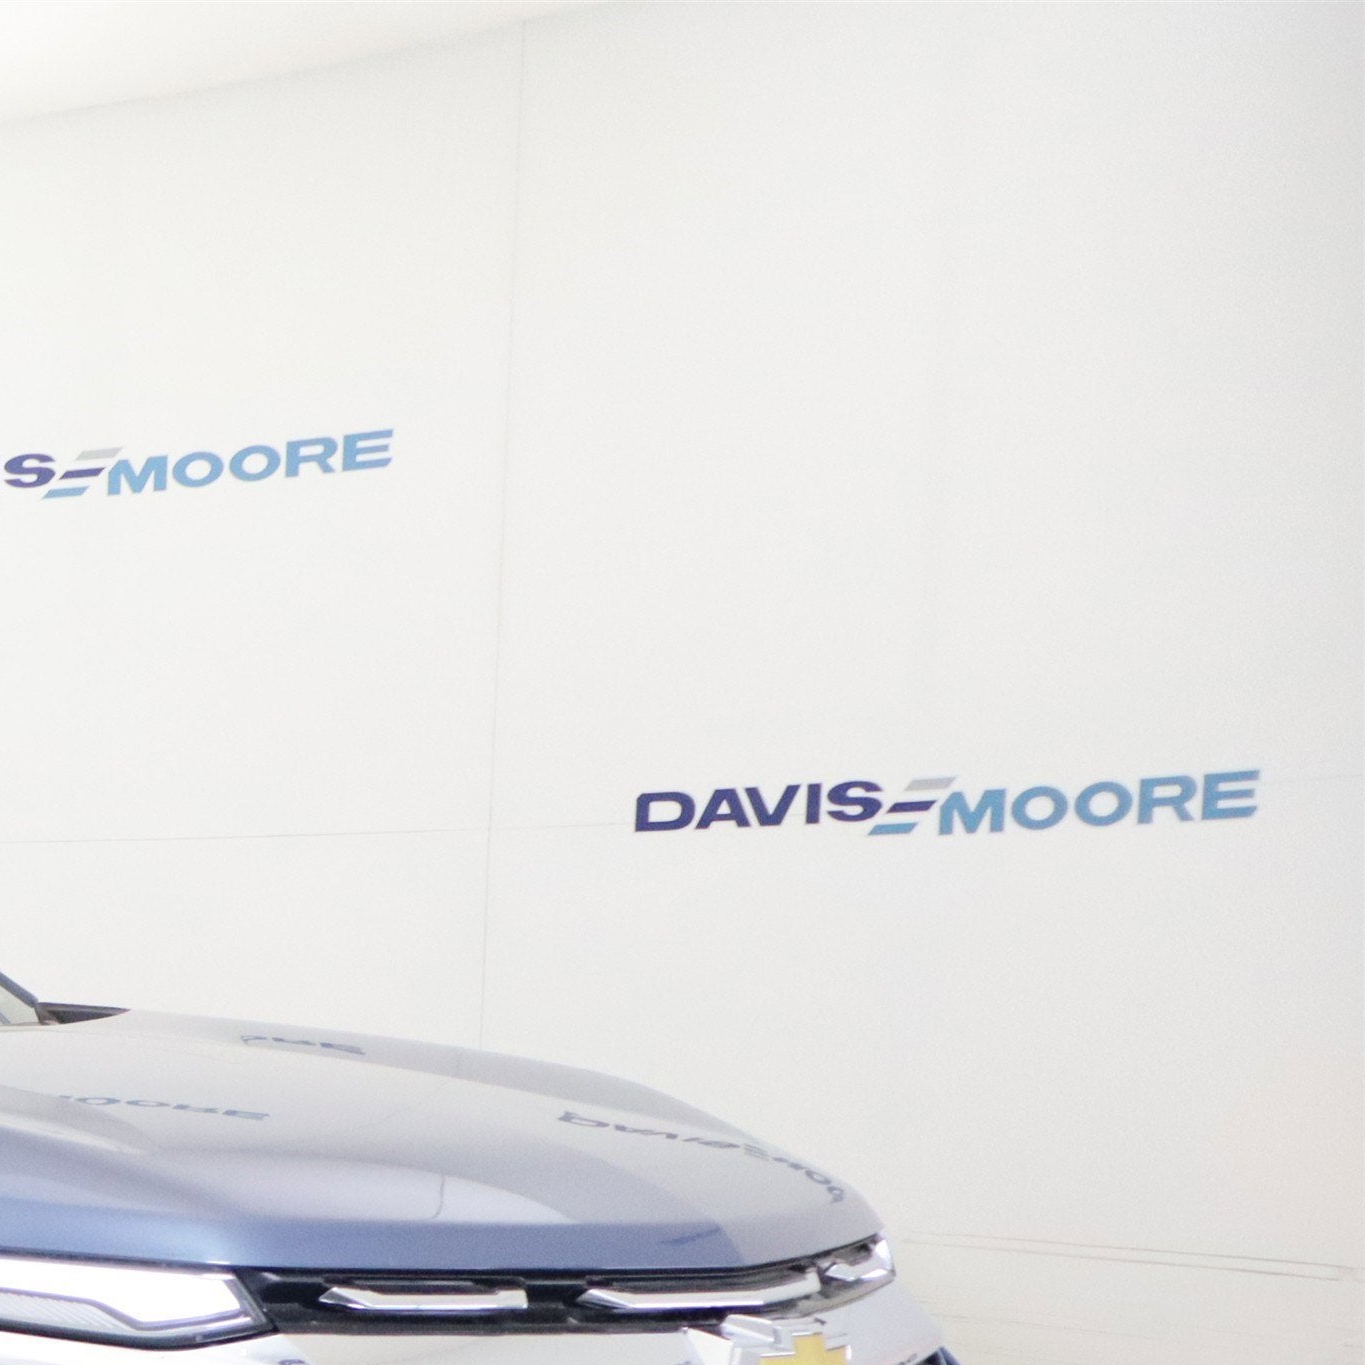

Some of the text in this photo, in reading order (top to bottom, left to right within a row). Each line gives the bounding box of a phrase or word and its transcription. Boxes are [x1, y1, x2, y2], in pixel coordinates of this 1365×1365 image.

[107, 428, 395, 496] MOORE
[633, 768, 1262, 836] DAVIS MOORE
